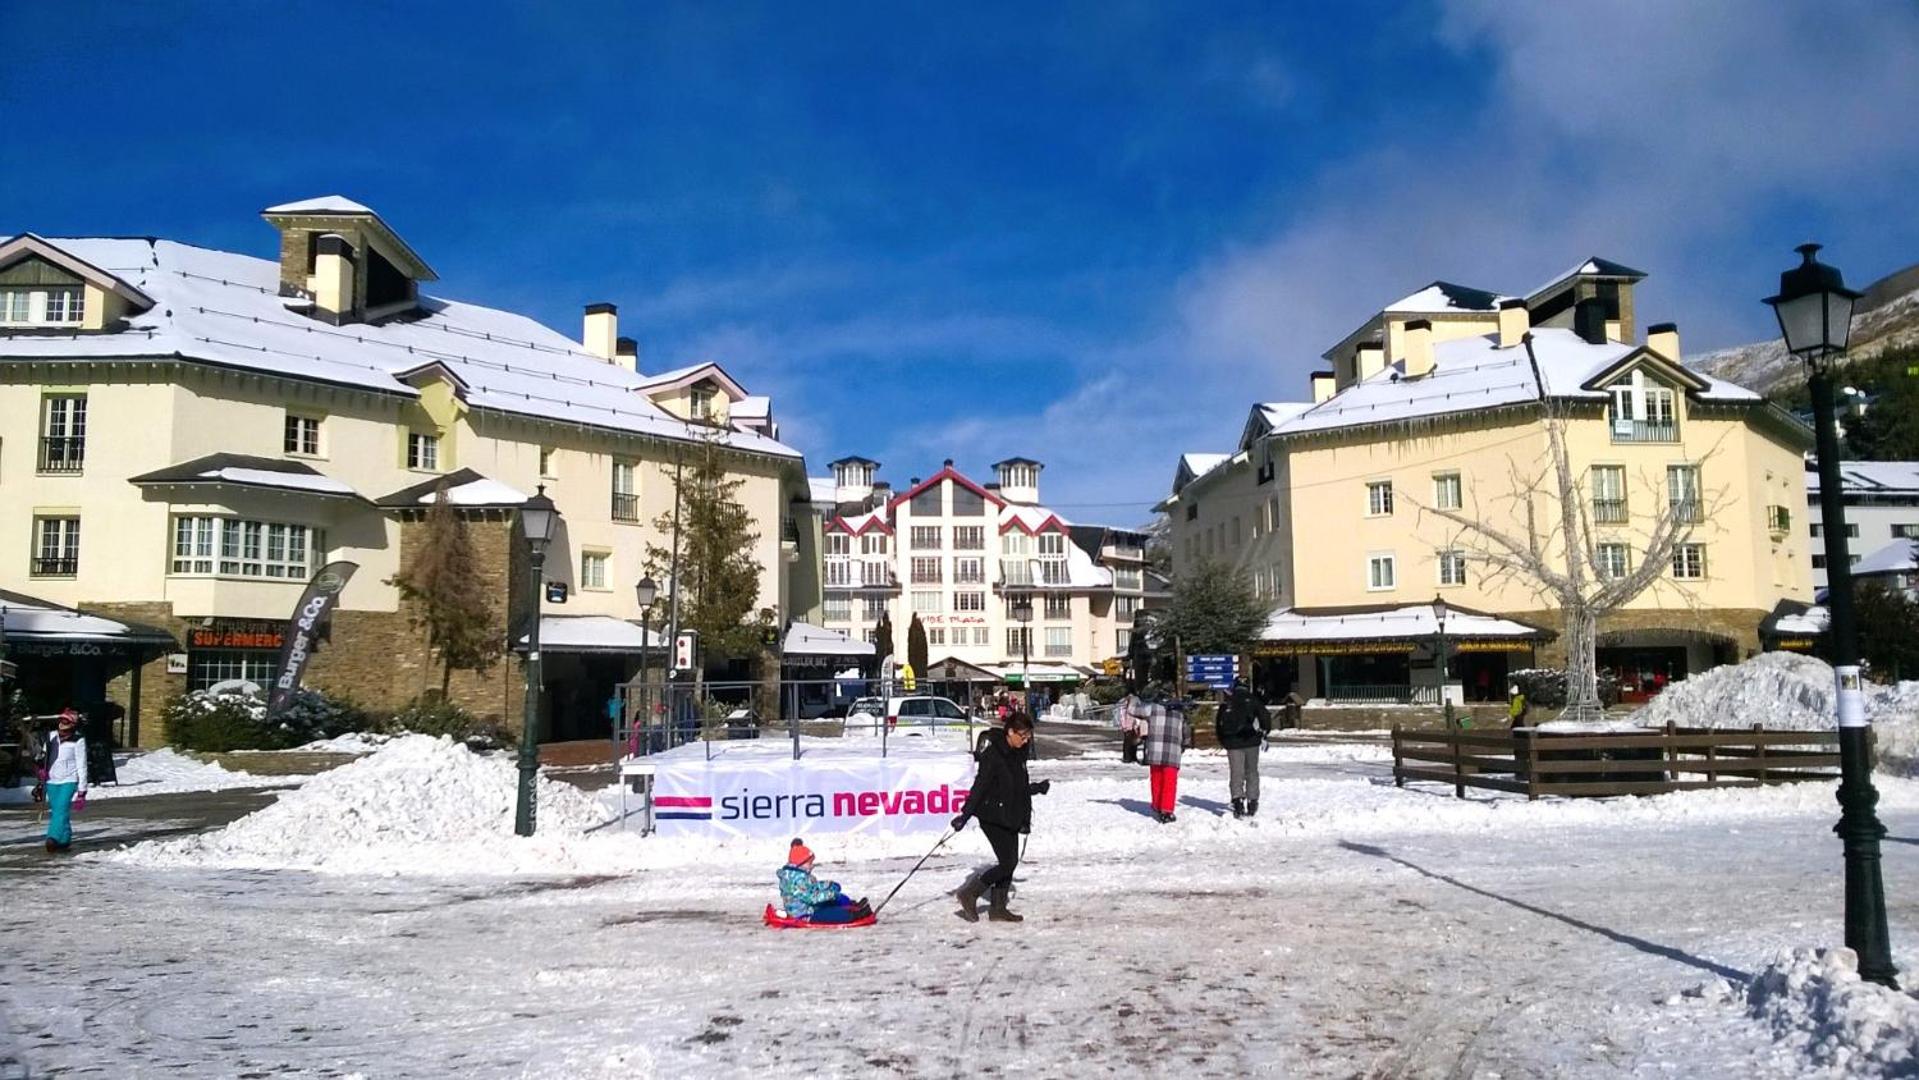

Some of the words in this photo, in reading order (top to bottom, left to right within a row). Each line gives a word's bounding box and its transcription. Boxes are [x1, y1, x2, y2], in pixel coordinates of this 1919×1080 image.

[194, 632, 283, 647] SUPERMERC
[278, 631, 309, 689] Burger
[721, 788, 824, 819] sierra
[833, 784, 970, 816] nevada
